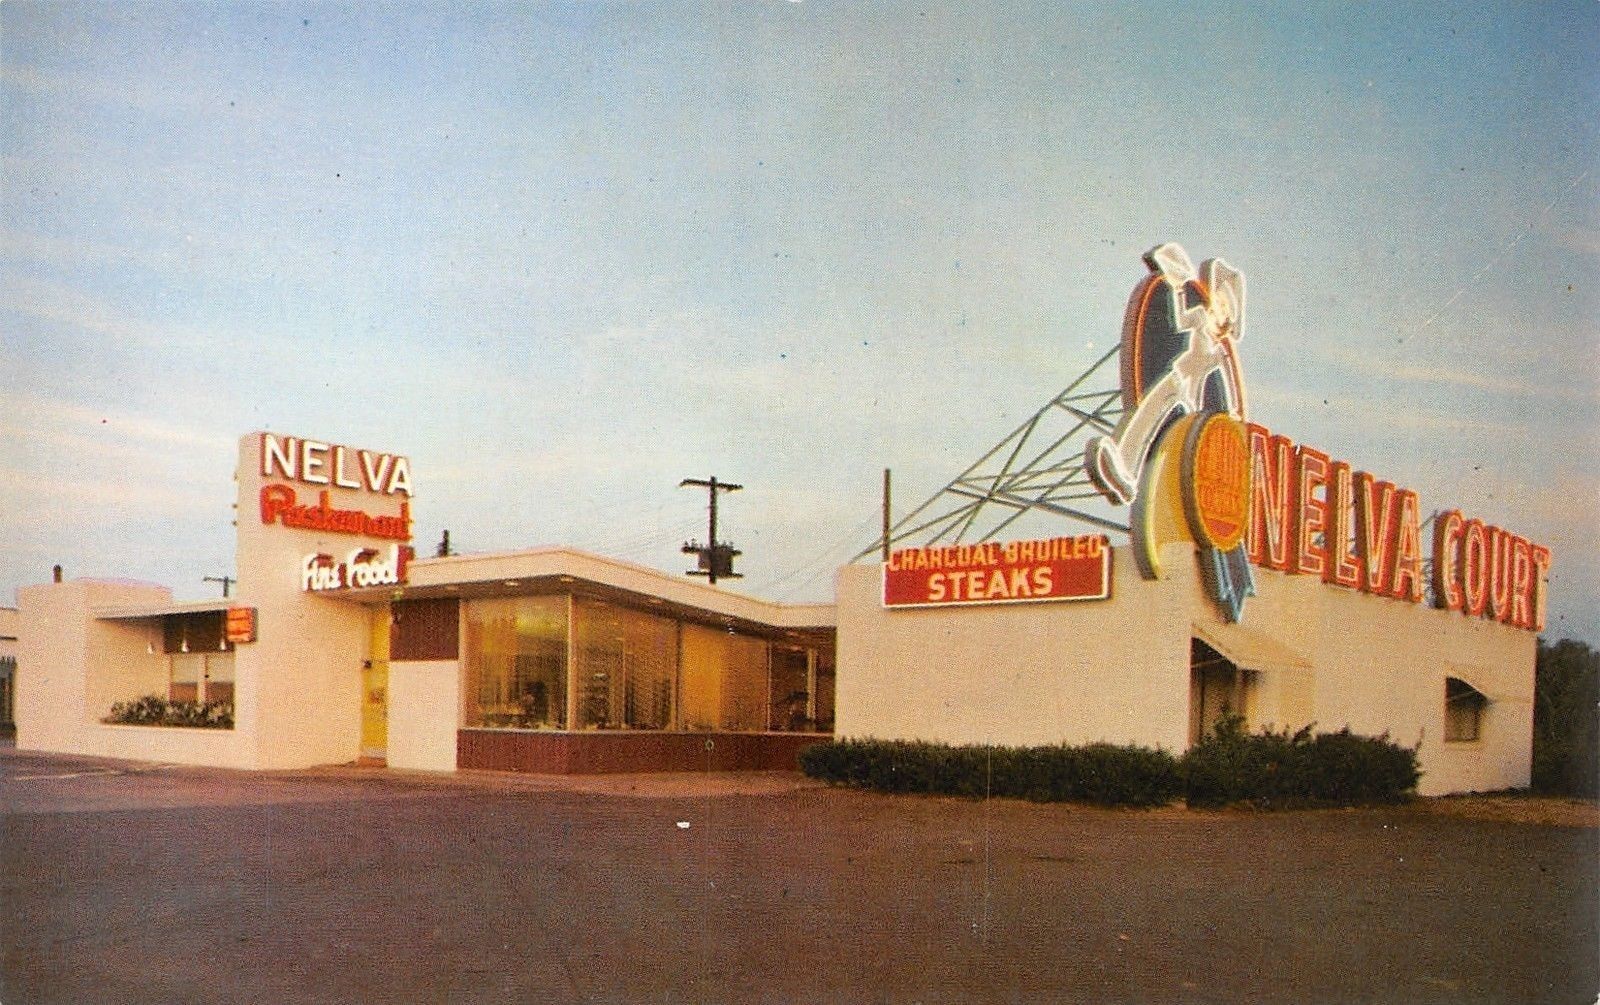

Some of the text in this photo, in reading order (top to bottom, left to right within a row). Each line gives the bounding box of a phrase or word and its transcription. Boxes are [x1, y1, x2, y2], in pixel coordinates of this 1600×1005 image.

[260, 433, 413, 497] NELVA
[1246, 422, 1425, 604] NELVA
[1432, 508, 1552, 632] COURT
[345, 542, 401, 588] Food
[888, 535, 1105, 572] CHARCOAL BROILED
[928, 565, 1054, 601] STEAKS
